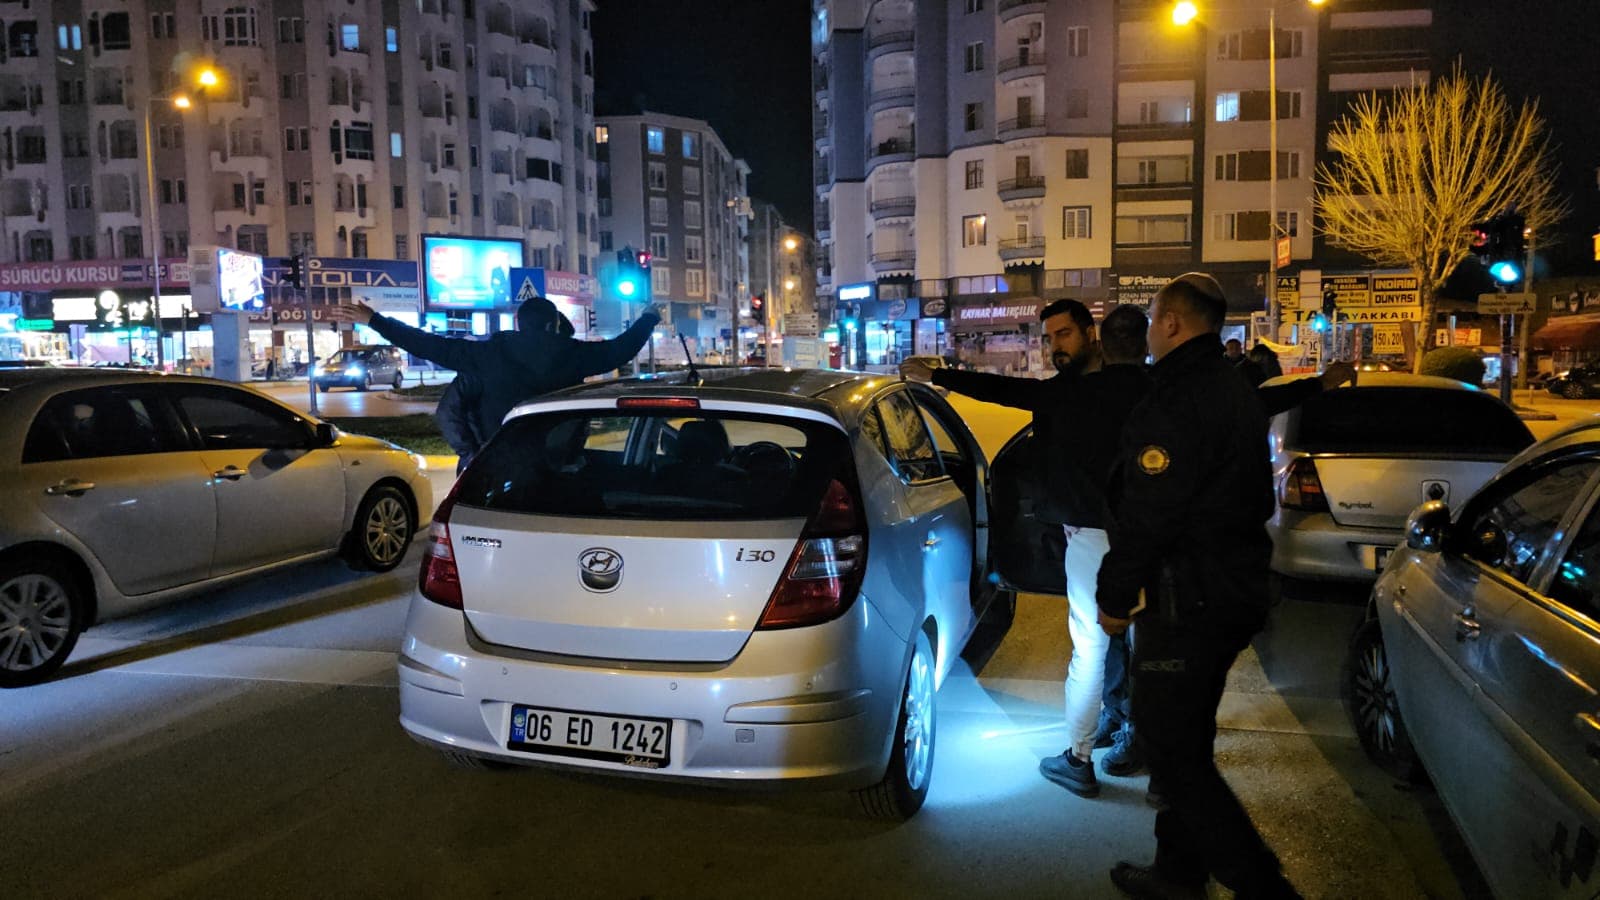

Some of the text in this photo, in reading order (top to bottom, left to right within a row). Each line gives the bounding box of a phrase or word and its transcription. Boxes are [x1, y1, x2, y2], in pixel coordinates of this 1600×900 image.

[2, 266, 62, 285] SÜRÜCÜ
[66, 266, 119, 282] KURSU
[1134, 275, 1172, 286] Polisan
[547, 277, 579, 292] KURSU
[735, 547, 776, 563] i30
[514, 713, 665, 755] TR 06 ED 1242
